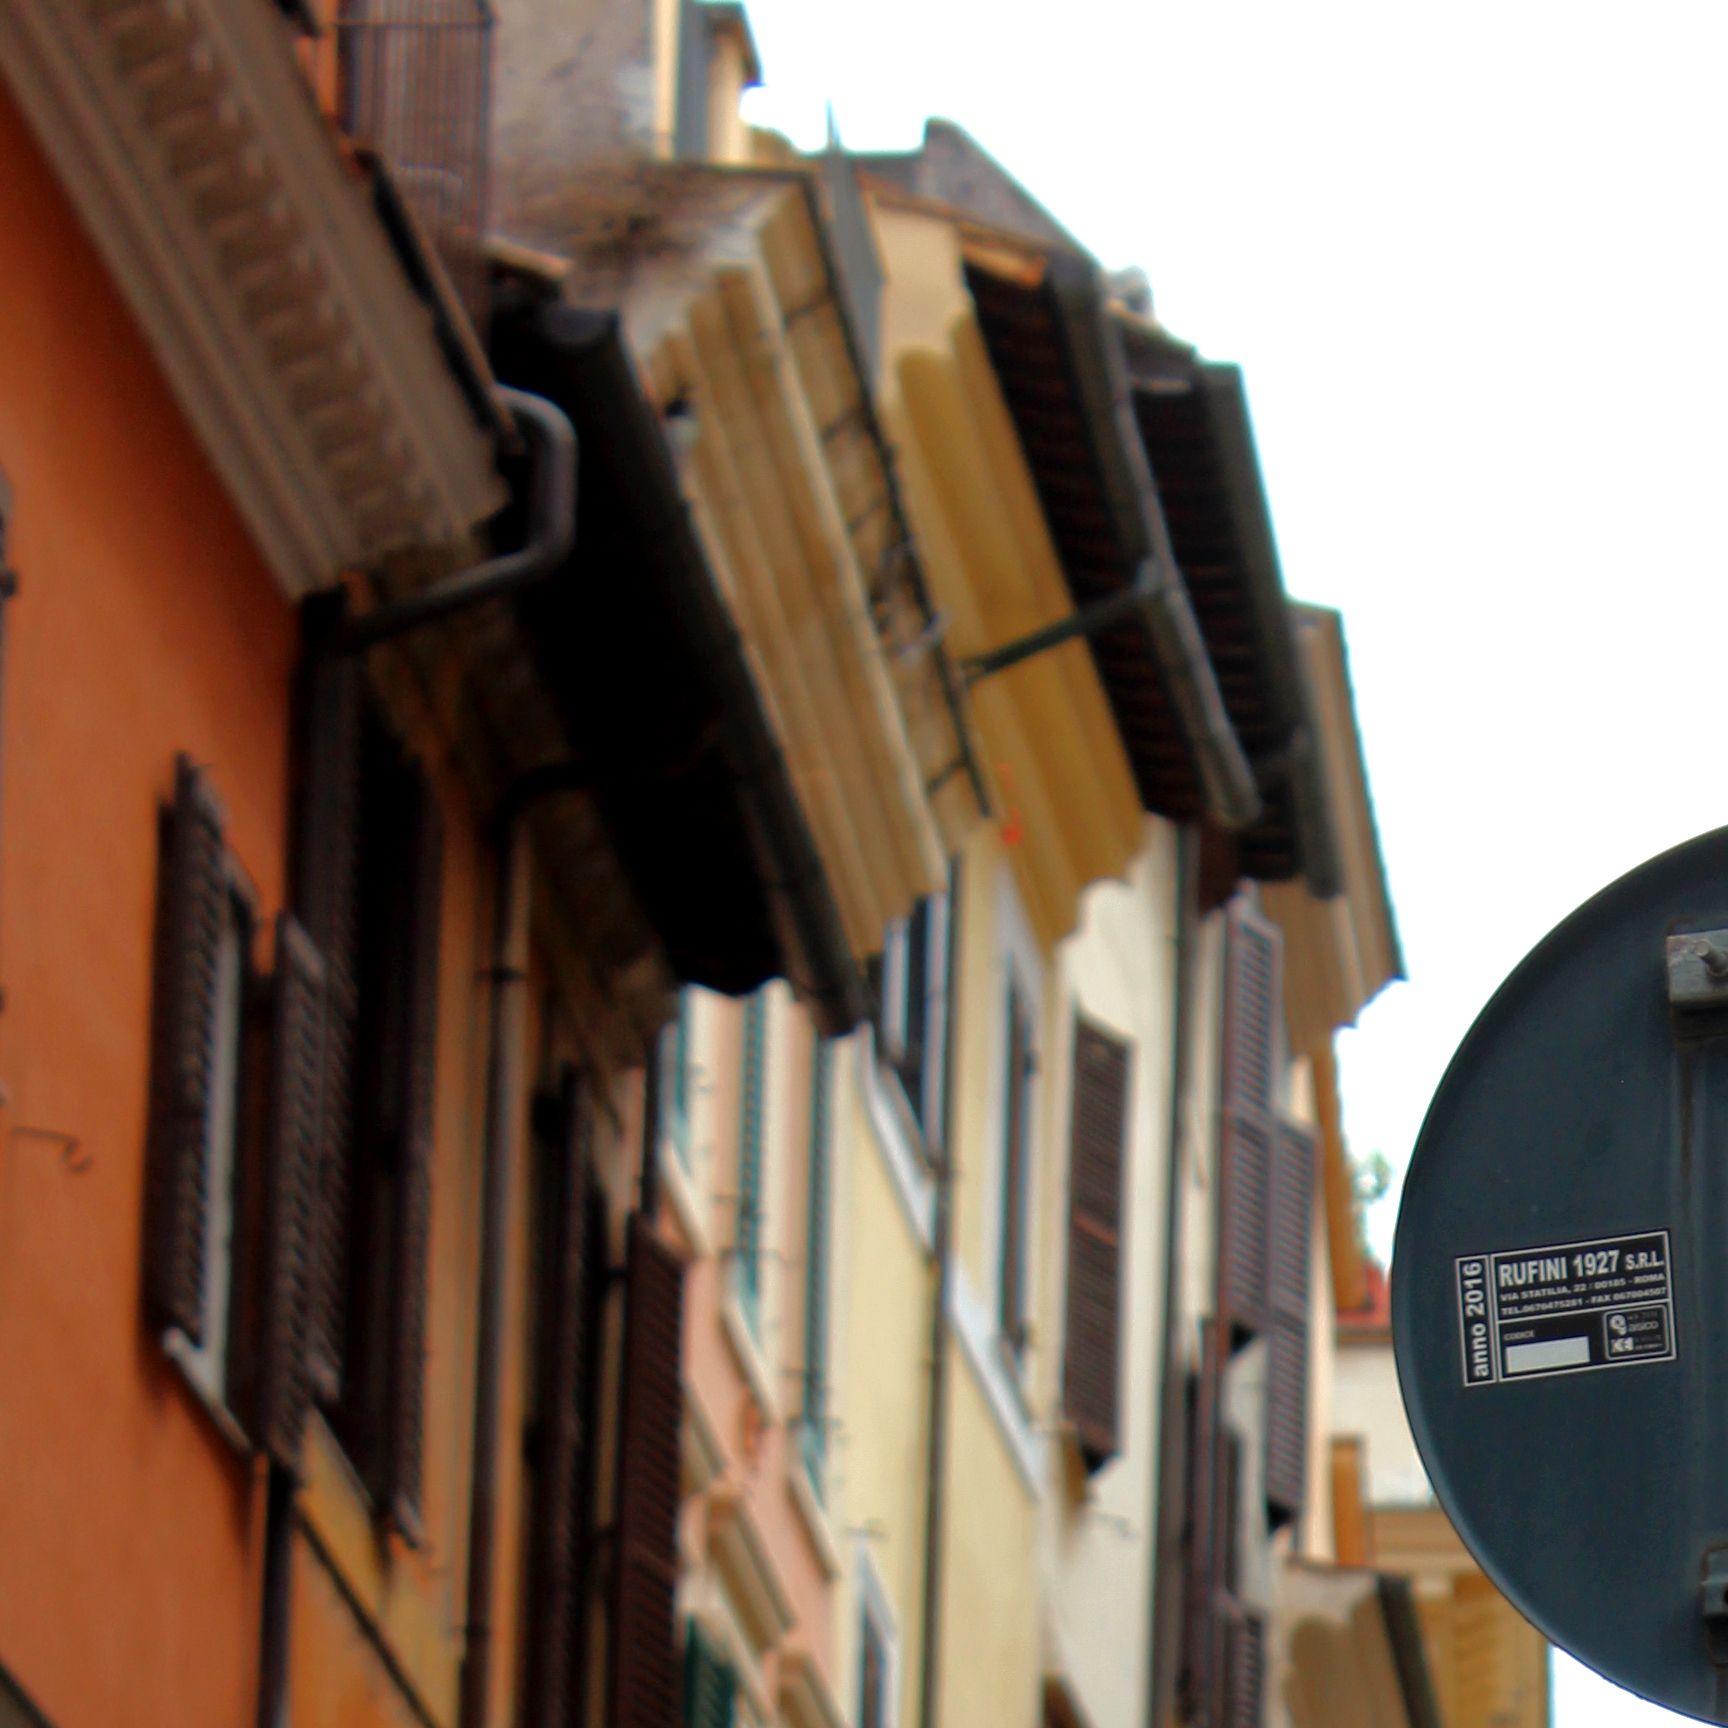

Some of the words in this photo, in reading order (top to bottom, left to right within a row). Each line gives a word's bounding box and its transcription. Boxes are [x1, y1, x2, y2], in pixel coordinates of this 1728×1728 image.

[1500, 1257, 1567, 1287] RUFINI
[1573, 1250, 1619, 1277] 1927
[1625, 1250, 1665, 1271] S.R.L.
[1463, 1262, 1485, 1317] 2016
[1501, 1291, 1518, 1302] VIA
[1633, 1273, 1665, 1285] ROMA
[1591, 1294, 1611, 1305] FAX
[1471, 1322, 1488, 1378] anno
